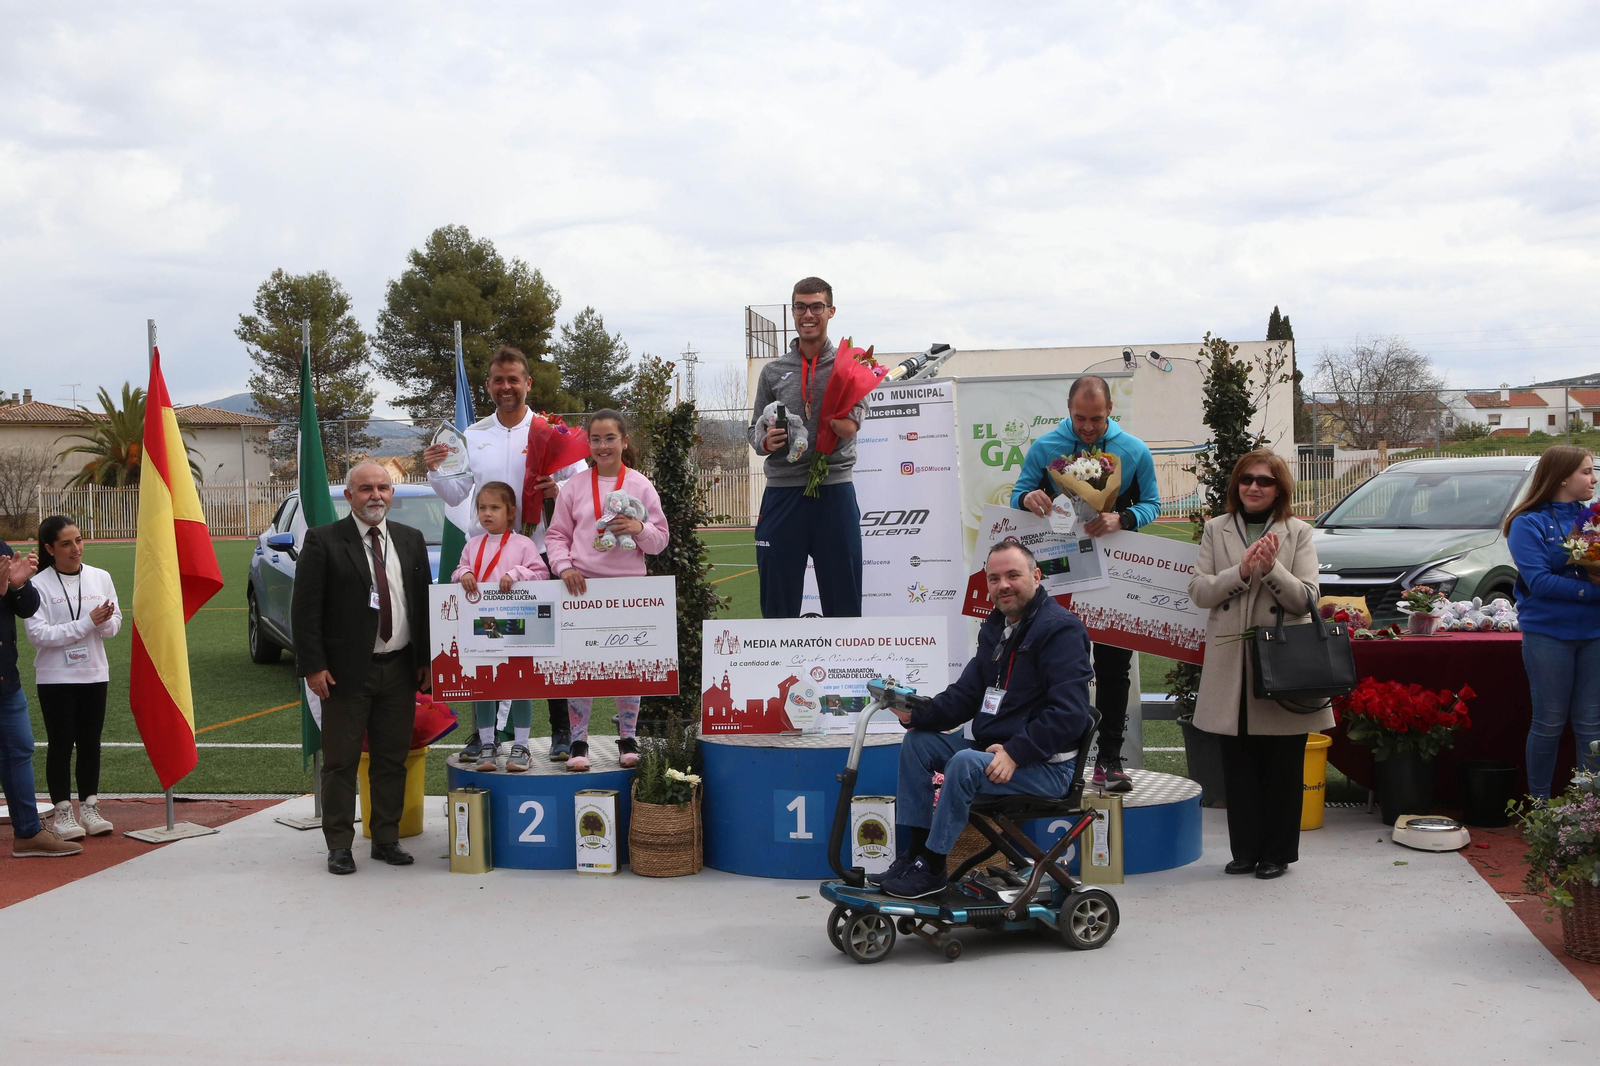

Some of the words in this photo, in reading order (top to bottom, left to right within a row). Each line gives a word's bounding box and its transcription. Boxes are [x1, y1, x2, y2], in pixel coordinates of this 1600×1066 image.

[870, 392, 884, 402] VO
[890, 388, 944, 400] MUNICIPAL
[865, 407, 918, 418] slucena.es
[972, 423, 998, 440] EL
[980, 440, 1028, 472] GA
[860, 508, 930, 527] SDM
[1113, 550, 1154, 566] CIUDAD
[1156, 558, 1172, 570] DE
[1174, 562, 1194, 574] LUC
[1122, 568, 1153, 584] Euros
[562, 600, 602, 610] CIUDAD
[606, 599, 620, 608] DE
[622, 598, 664, 608] LUCENA
[1126, 592, 1142, 600] EUR:
[1150, 594, 1170, 606] 50
[604, 634, 630, 646] 100
[633, 630, 648, 646] €
[743, 640, 778, 648] MEDIA
[780, 636, 832, 648] MARATÓN
[834, 638, 876, 648] CIUDAD
[878, 638, 892, 646] DE
[894, 636, 937, 646] LUCENA
[518, 800, 546, 843] 2
[786, 796, 814, 839] 1
